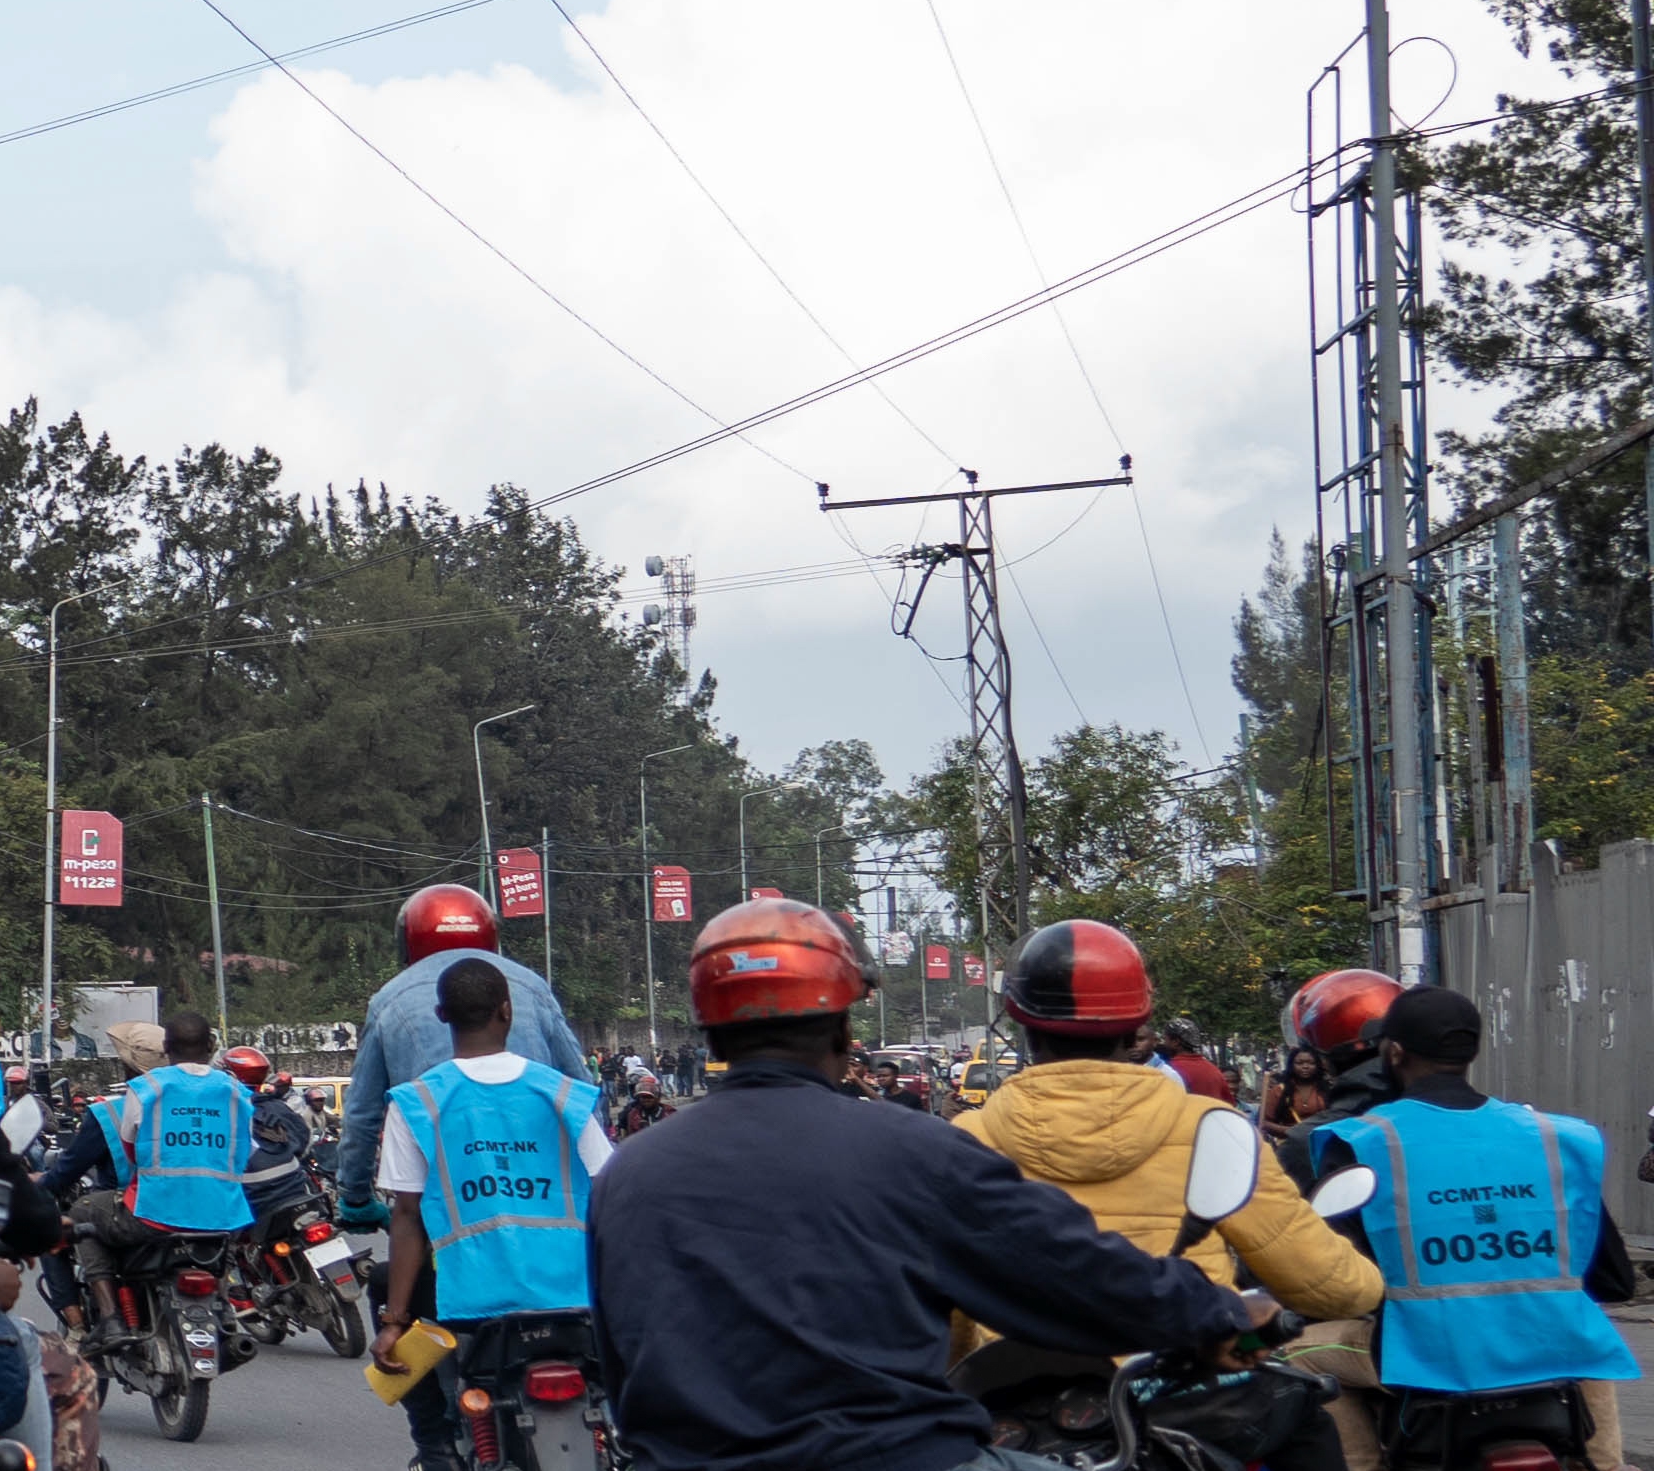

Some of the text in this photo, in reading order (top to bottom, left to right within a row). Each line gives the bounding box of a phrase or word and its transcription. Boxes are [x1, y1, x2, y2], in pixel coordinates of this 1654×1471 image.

[64, 859, 117, 872] m-pesa
[501, 872, 534, 887] M-Pesa
[503, 886, 515, 898] ya
[171, 1107, 220, 1117] CCMT-NK
[165, 1131, 226, 1149] 00310
[464, 1140, 538, 1155] CCMT-NK
[461, 1175, 552, 1202] 00397
[1427, 1184, 1536, 1205] CCMT-NK
[1421, 1230, 1556, 1266] 00364
